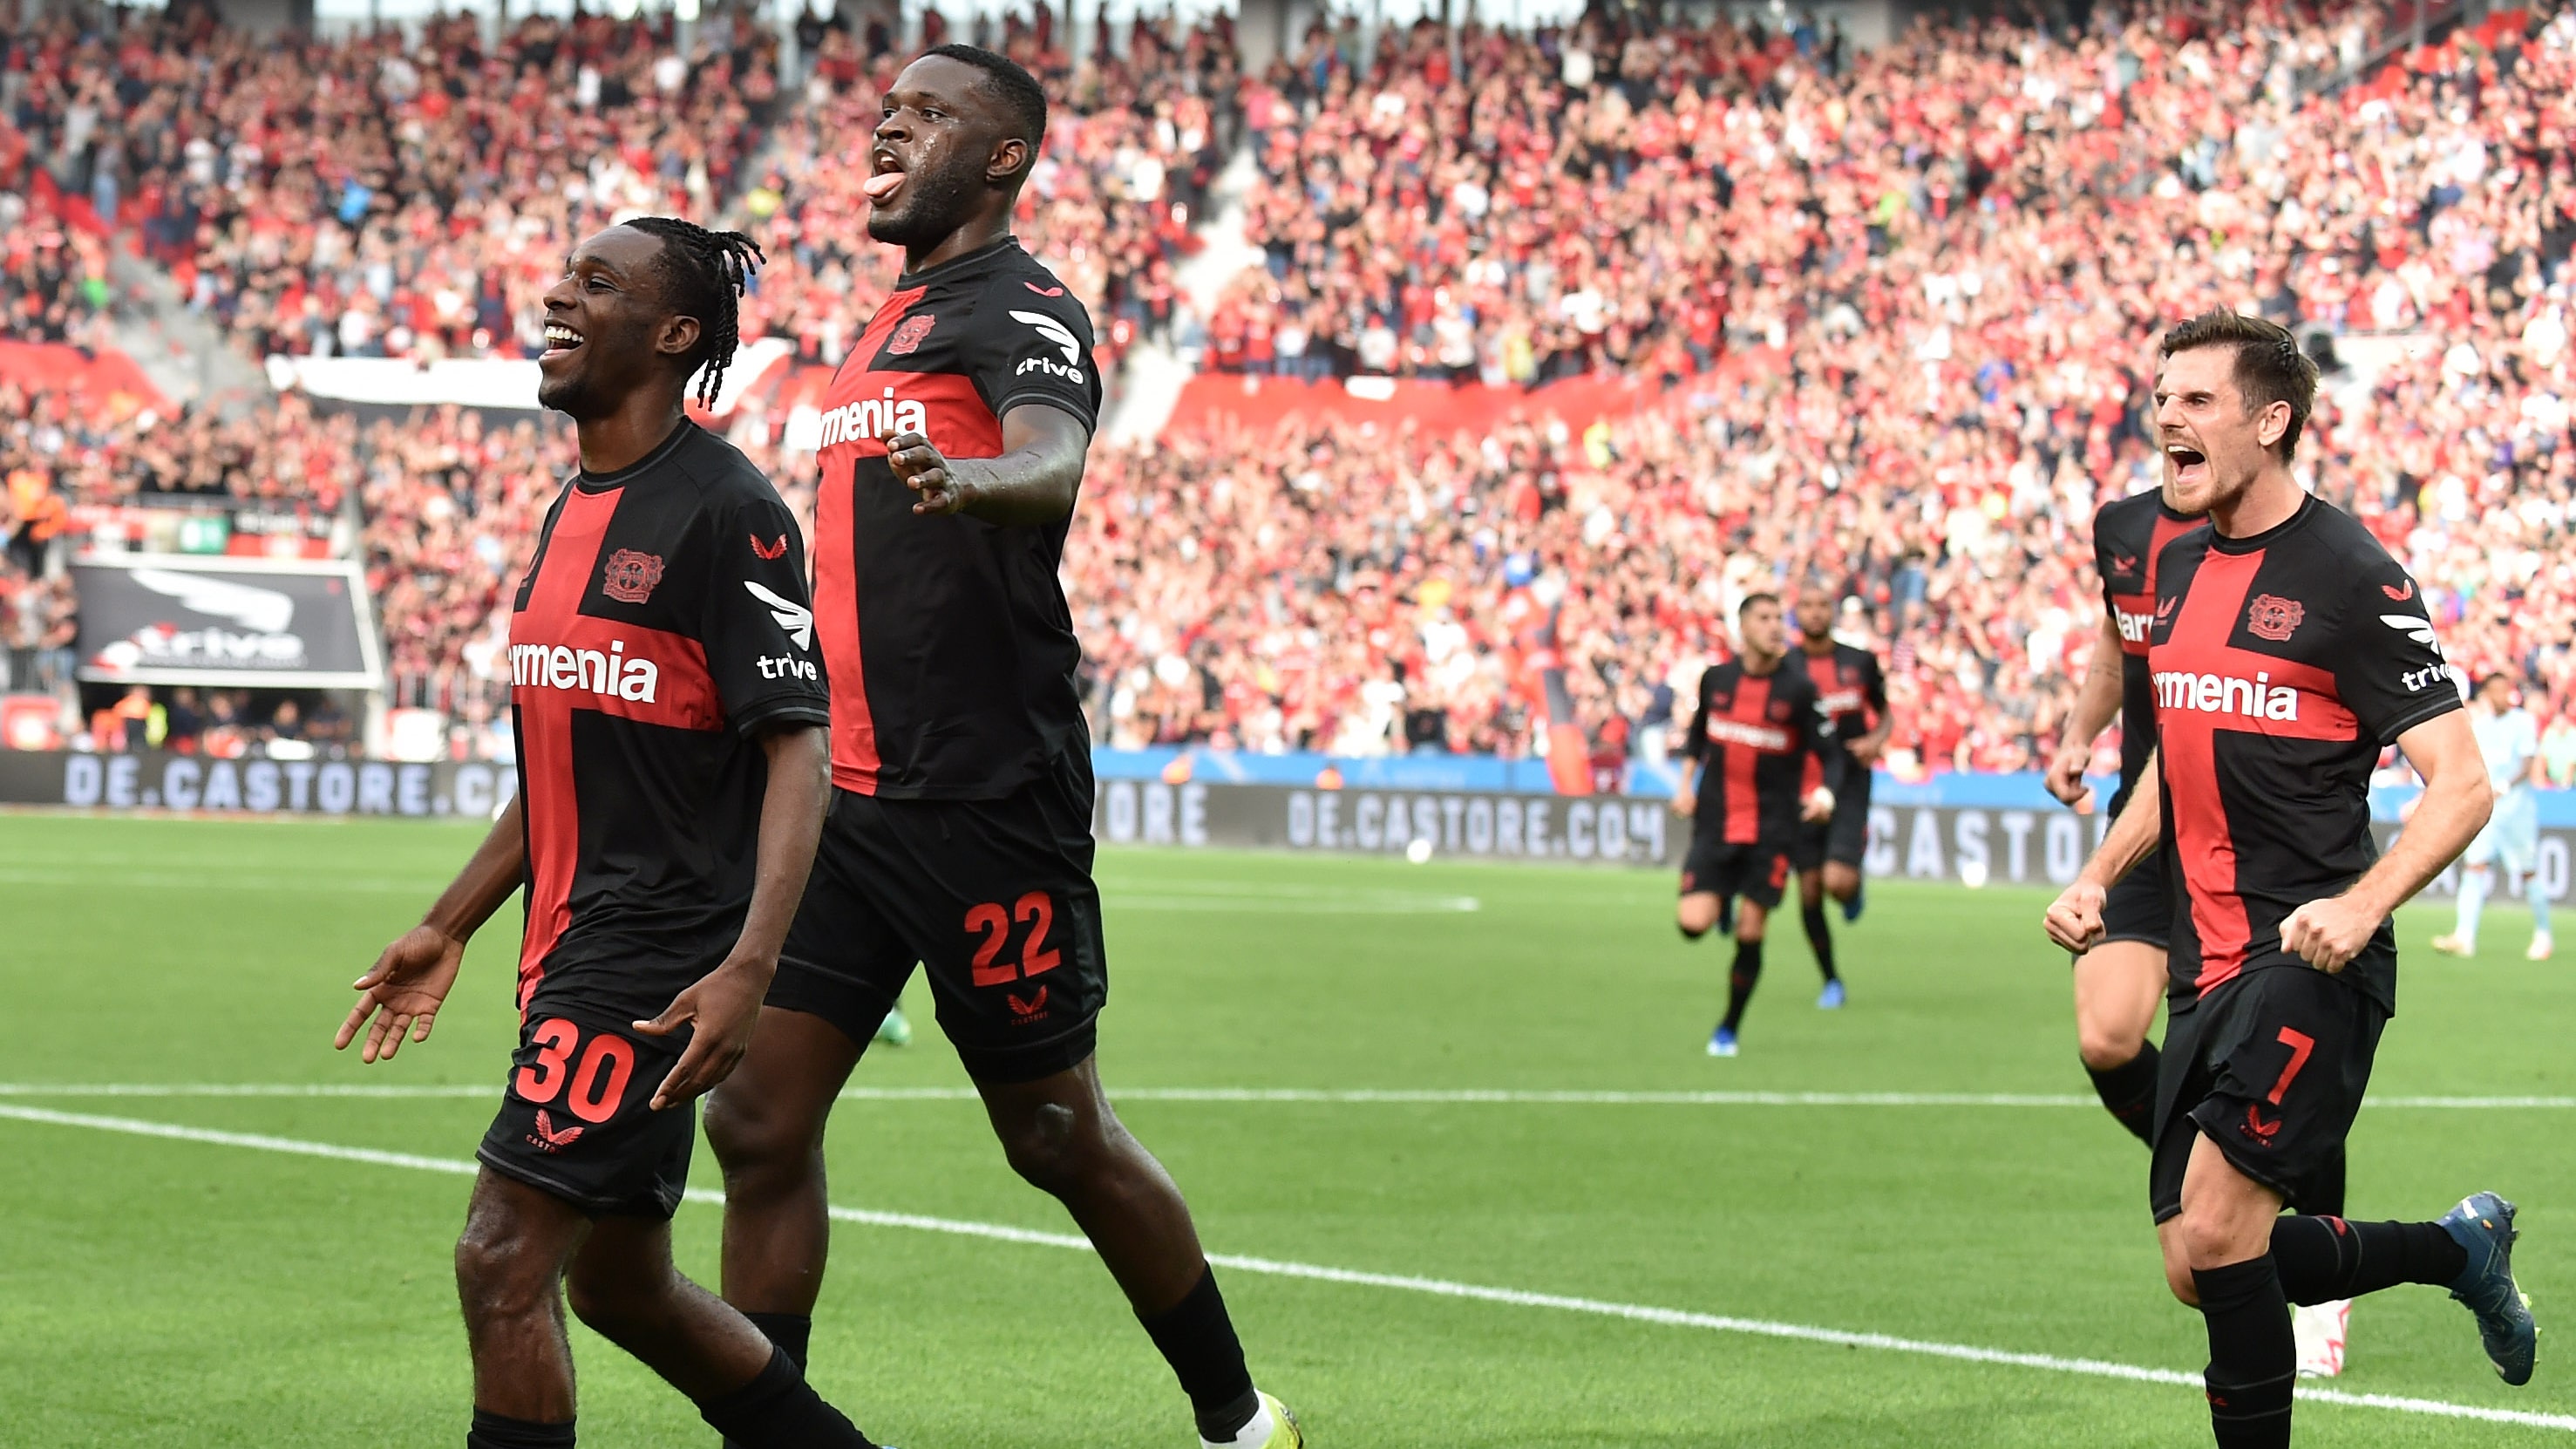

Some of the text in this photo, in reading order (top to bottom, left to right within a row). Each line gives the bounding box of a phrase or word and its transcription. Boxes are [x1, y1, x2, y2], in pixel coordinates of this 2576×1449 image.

[508, 640, 658, 703] rmenia
[757, 651, 818, 681] trive
[1863, 806, 2107, 886] CASTO
[964, 890, 1061, 987] 22
[516, 1017, 635, 1123] 30
[2267, 1025, 2315, 1105] 7
